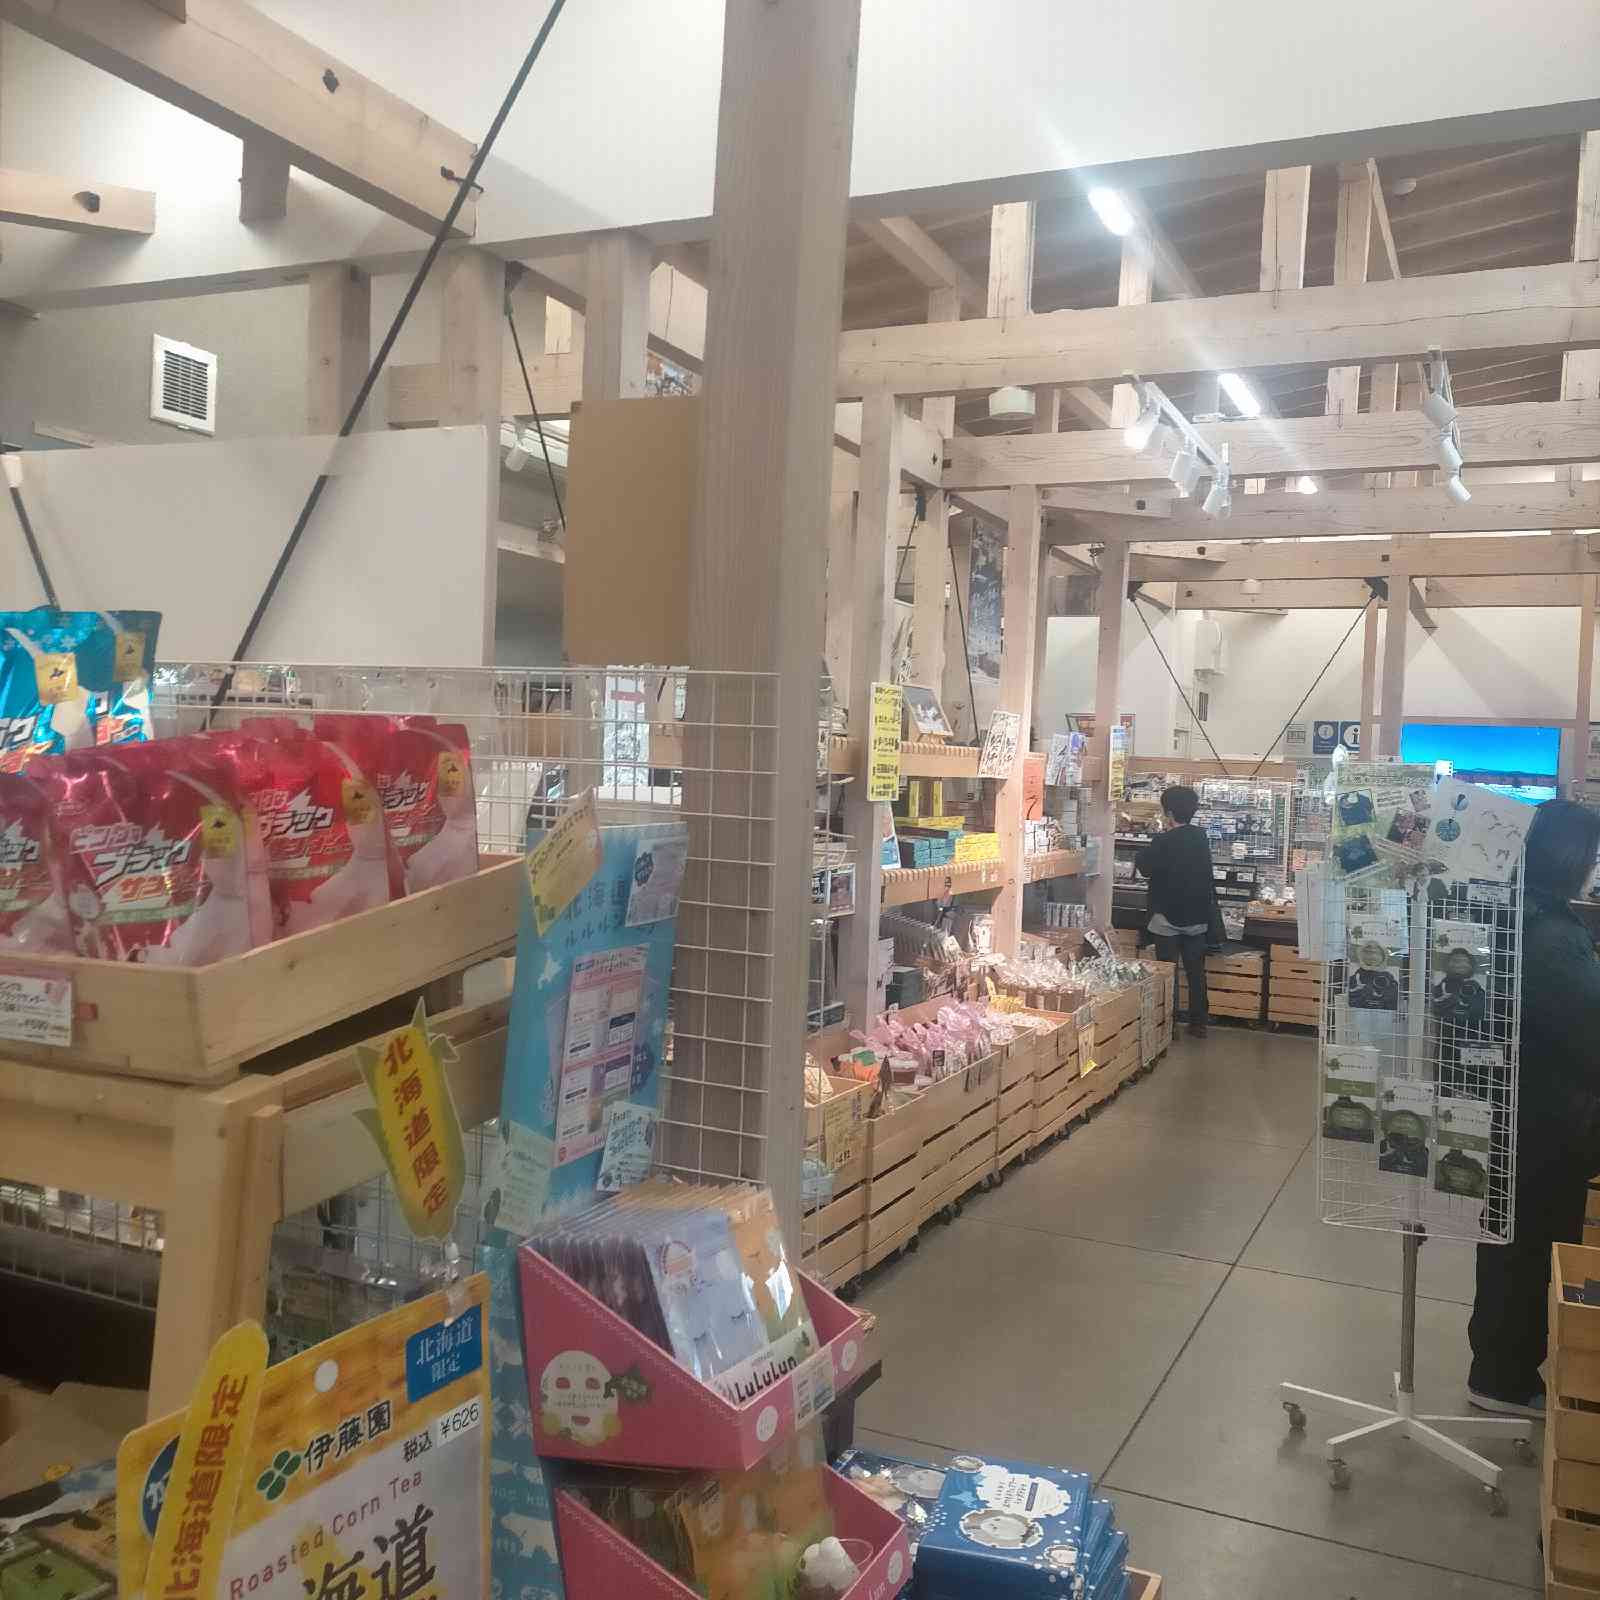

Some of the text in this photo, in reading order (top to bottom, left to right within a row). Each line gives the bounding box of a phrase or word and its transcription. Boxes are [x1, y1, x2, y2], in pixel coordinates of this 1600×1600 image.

[95, 838, 192, 886] ブラック
[384, 1034, 448, 1218] 北海道限定
[303, 1399, 391, 1474] 伊藤園
[439, 1402, 480, 1438] ¥626
[229, 1470, 423, 1600] Roasted Corn Tea
